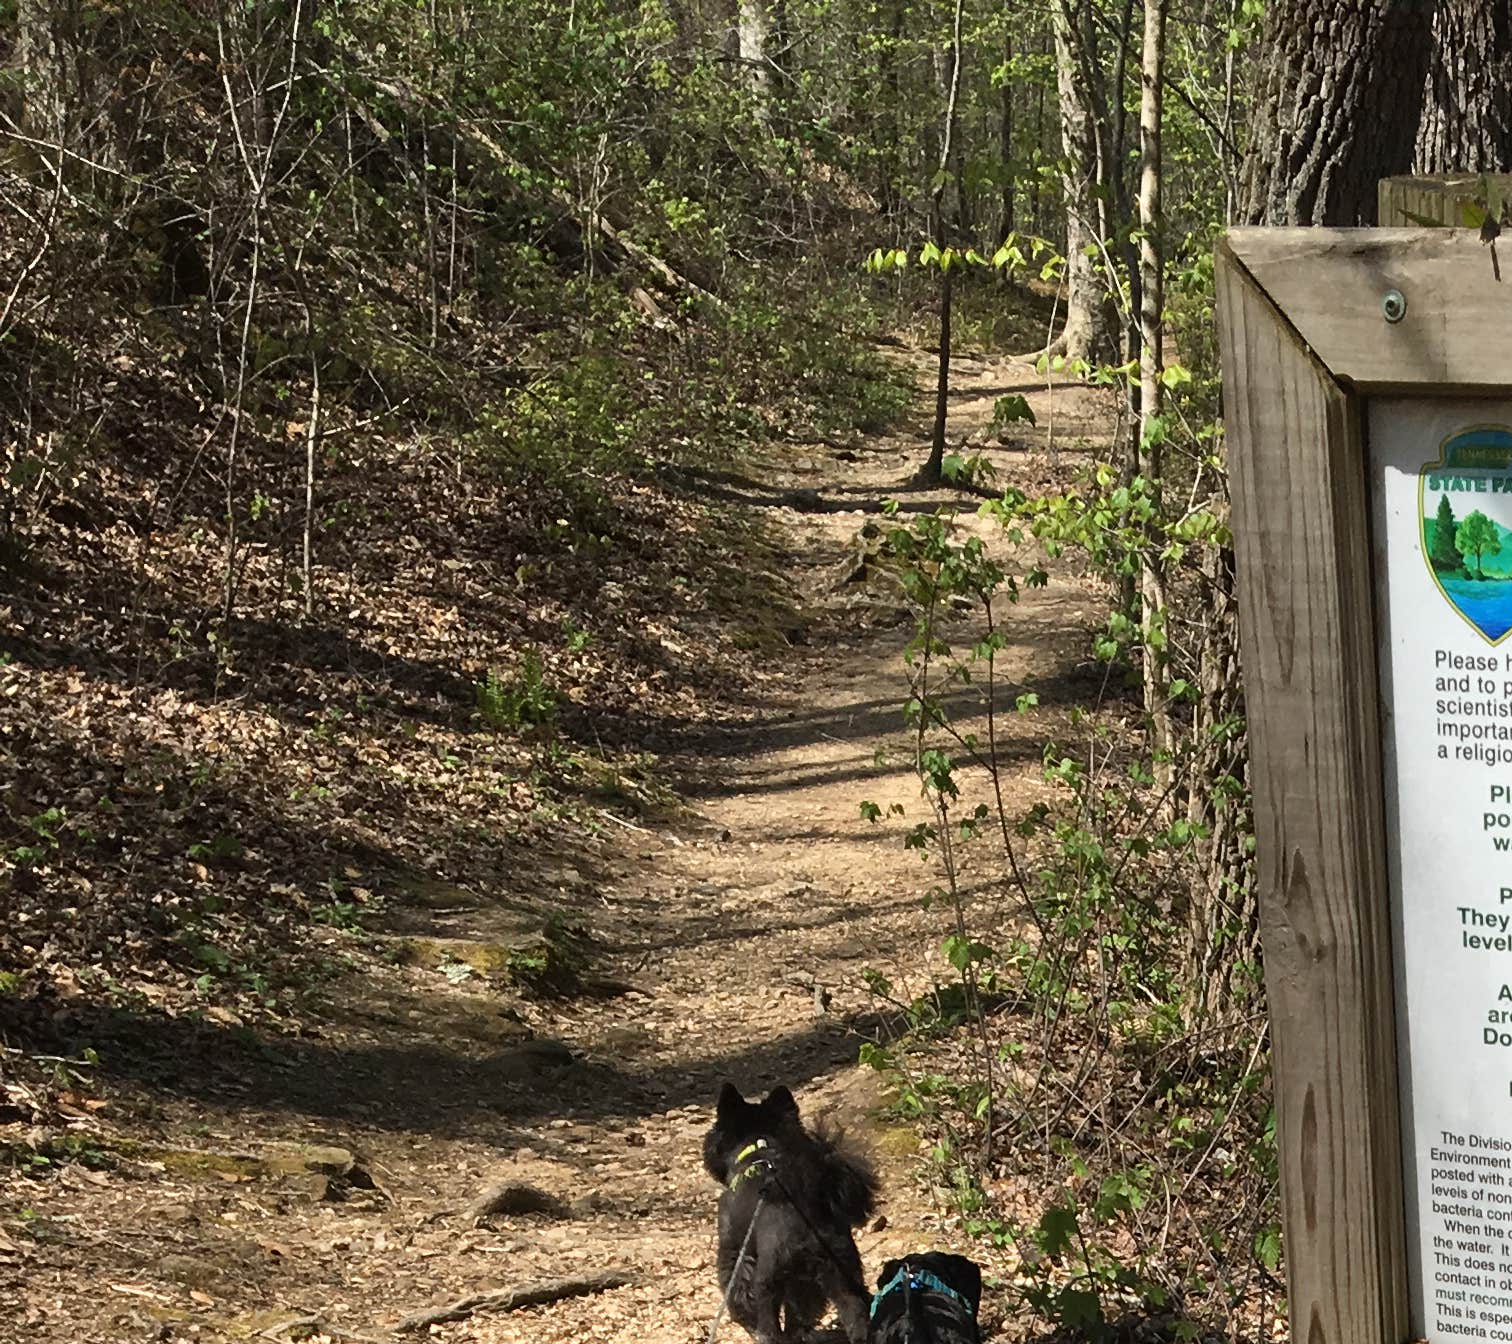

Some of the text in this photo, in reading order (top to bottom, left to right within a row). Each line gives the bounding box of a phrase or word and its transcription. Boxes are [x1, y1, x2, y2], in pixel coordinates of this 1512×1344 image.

[1428, 473, 1489, 492] STATE
[1434, 649, 1498, 672] Please
[1456, 906, 1510, 933] They
[1439, 1130, 1465, 1146] The
[1435, 1288, 1466, 1302] must
[1435, 1301, 1462, 1318] This
[1465, 1305, 1476, 1320] is
[1435, 1318, 1487, 1338] bacteria
